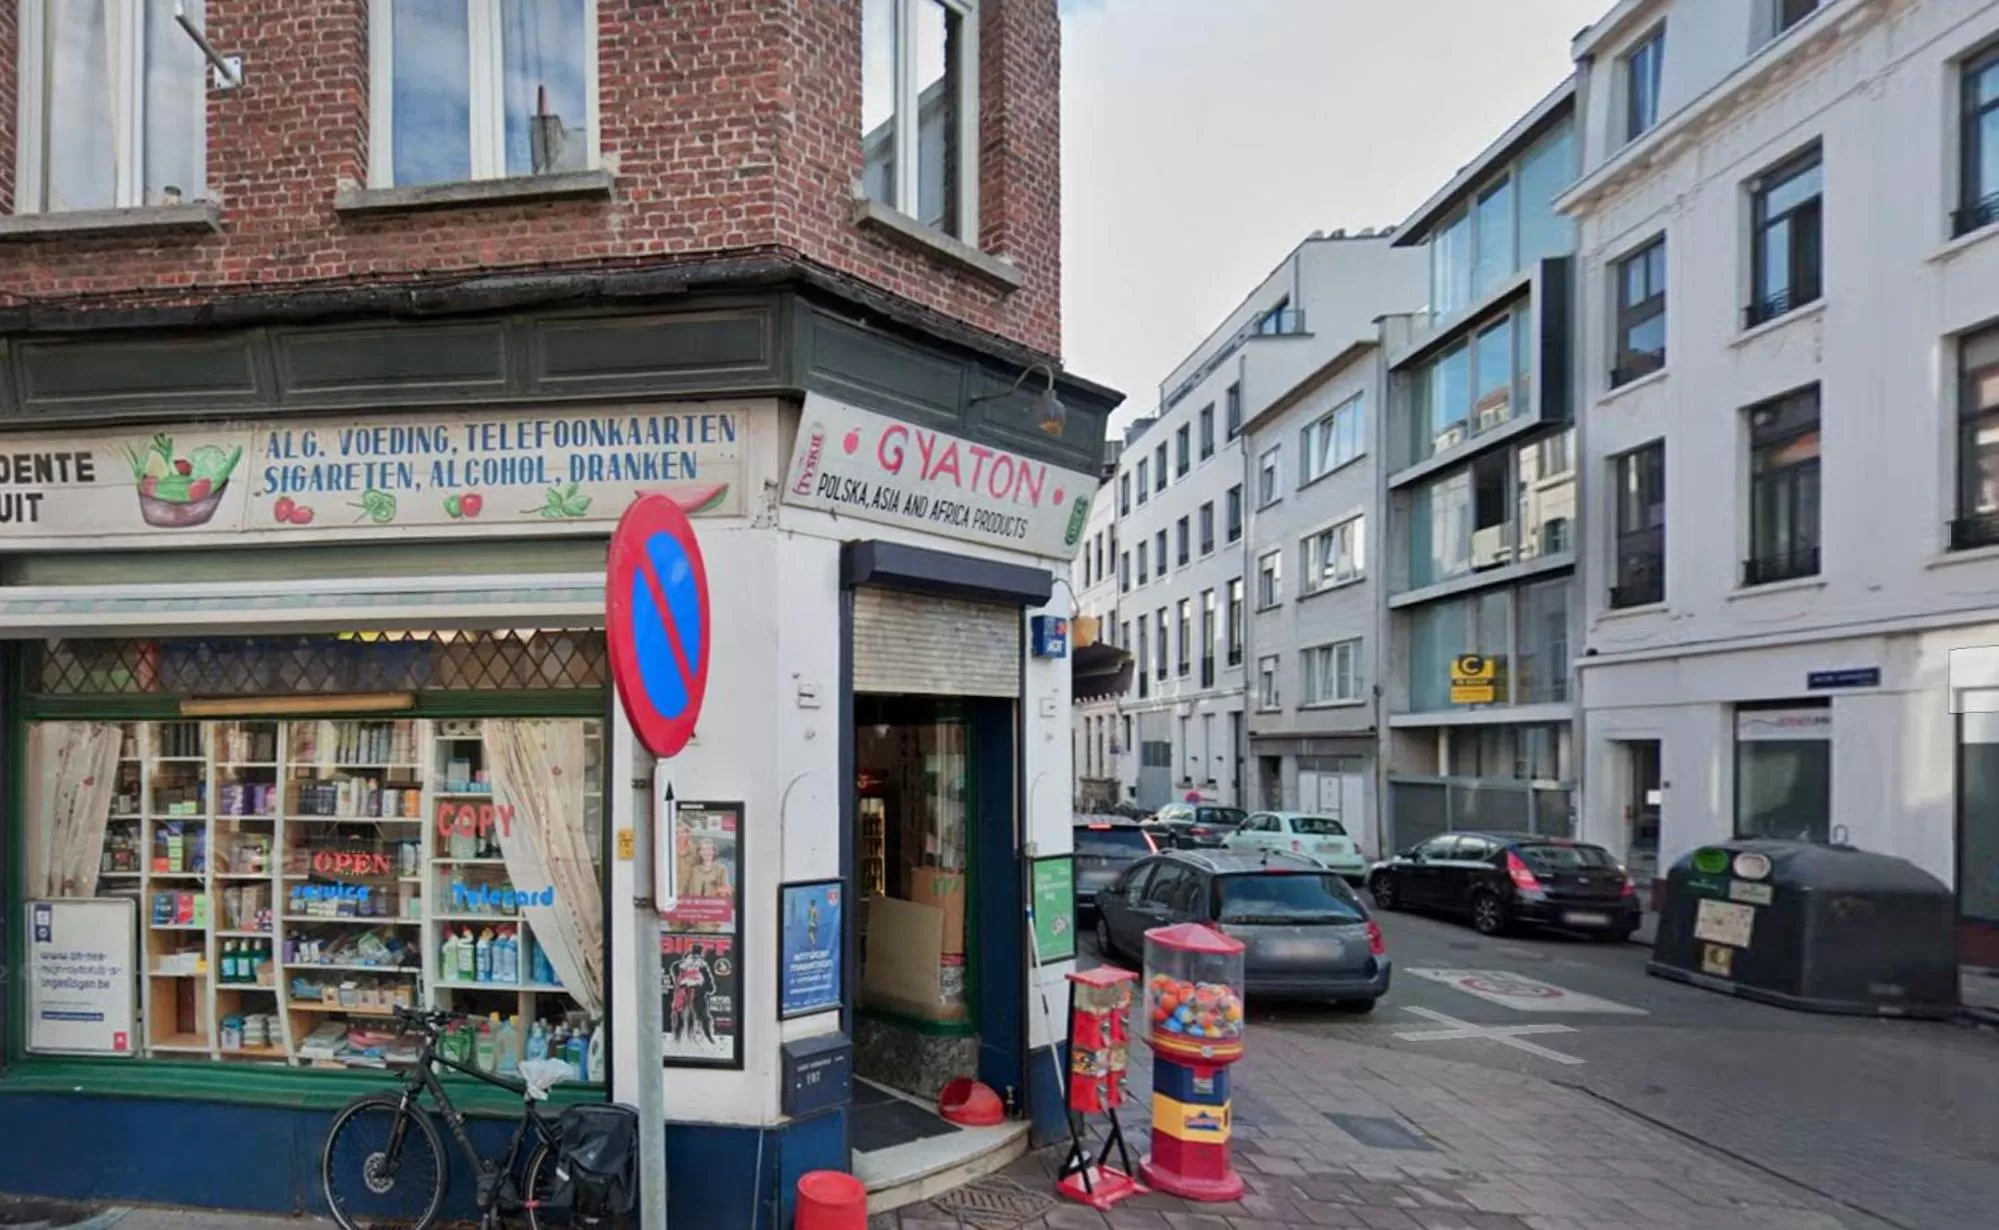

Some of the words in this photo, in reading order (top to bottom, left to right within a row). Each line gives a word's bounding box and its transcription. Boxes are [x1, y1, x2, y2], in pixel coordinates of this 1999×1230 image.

[266, 431, 326, 459] ALG.
[465, 414, 736, 452] TELEFOONKAARTEN
[263, 461, 422, 494] SIGARETEN,
[430, 455, 562, 487] ALCOHOL,
[569, 451, 698, 482] DRANKEN
[877, 424, 1047, 508] GYATON
[870, 485, 900, 513] ASIA
[902, 493, 928, 518] AND
[929, 499, 971, 529] AFRICA
[971, 508, 1029, 539] PRODUCTS
[436, 802, 515, 838] COPY
[314, 852, 391, 873] OPEN
